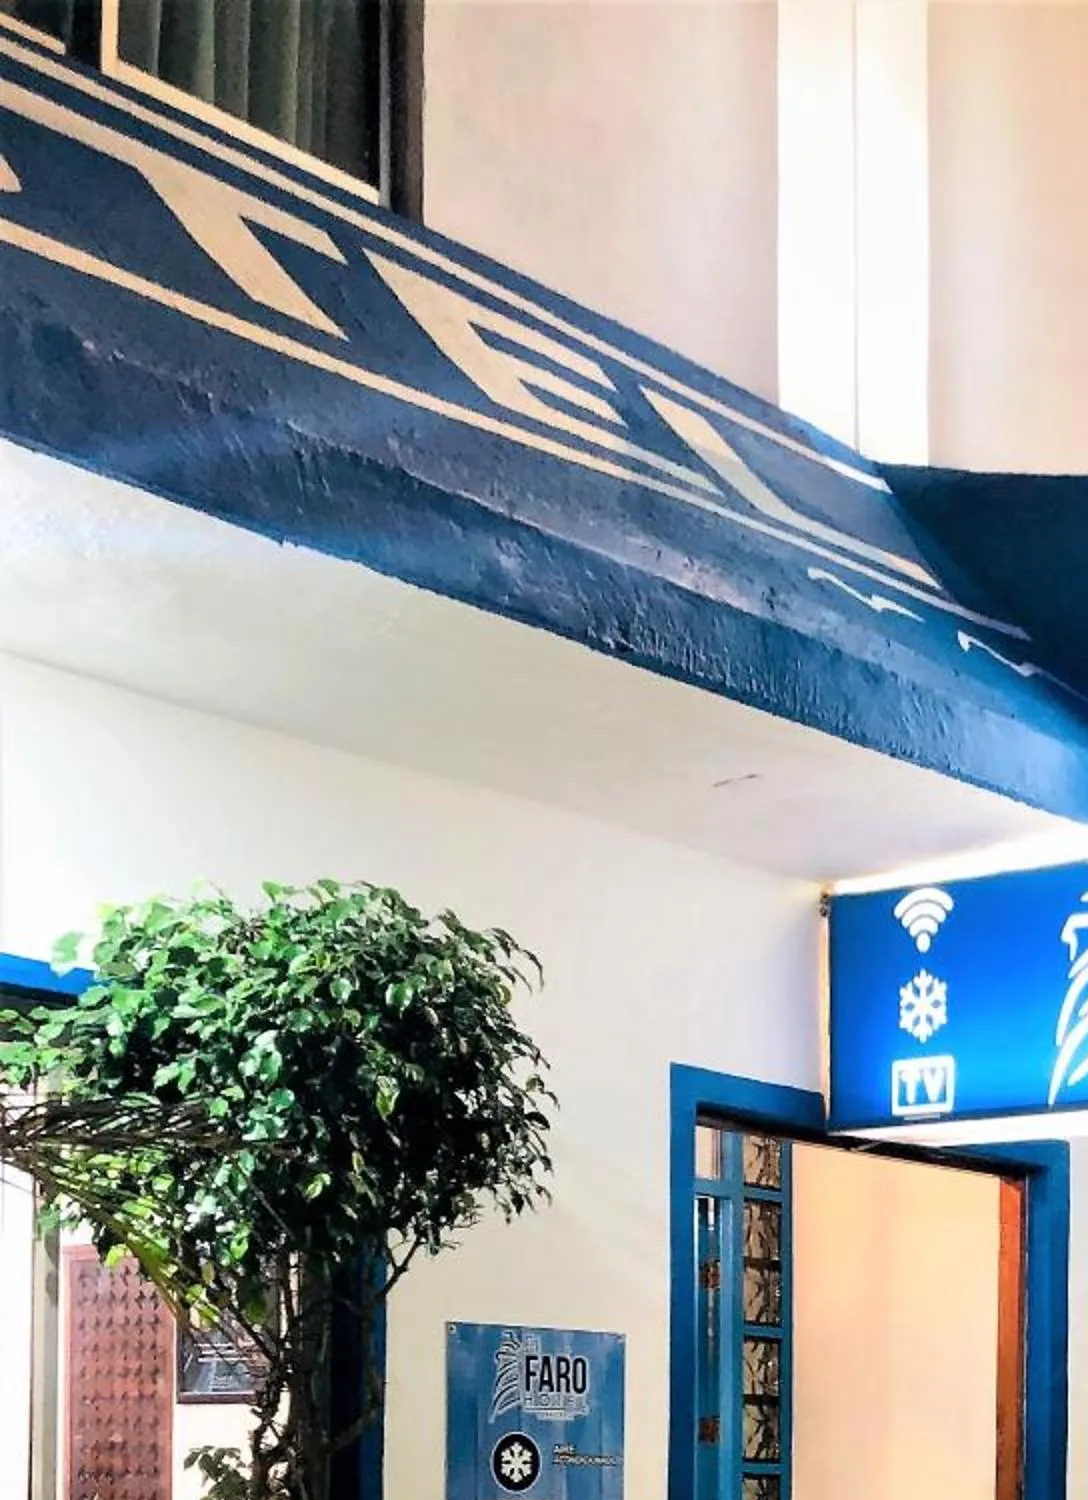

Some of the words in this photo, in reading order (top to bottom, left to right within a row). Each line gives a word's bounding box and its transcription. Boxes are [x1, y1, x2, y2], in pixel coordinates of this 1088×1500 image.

[0, 78, 942, 592] TEL
[899, 1066, 947, 1106] TV
[524, 1355, 588, 1395] FARO
